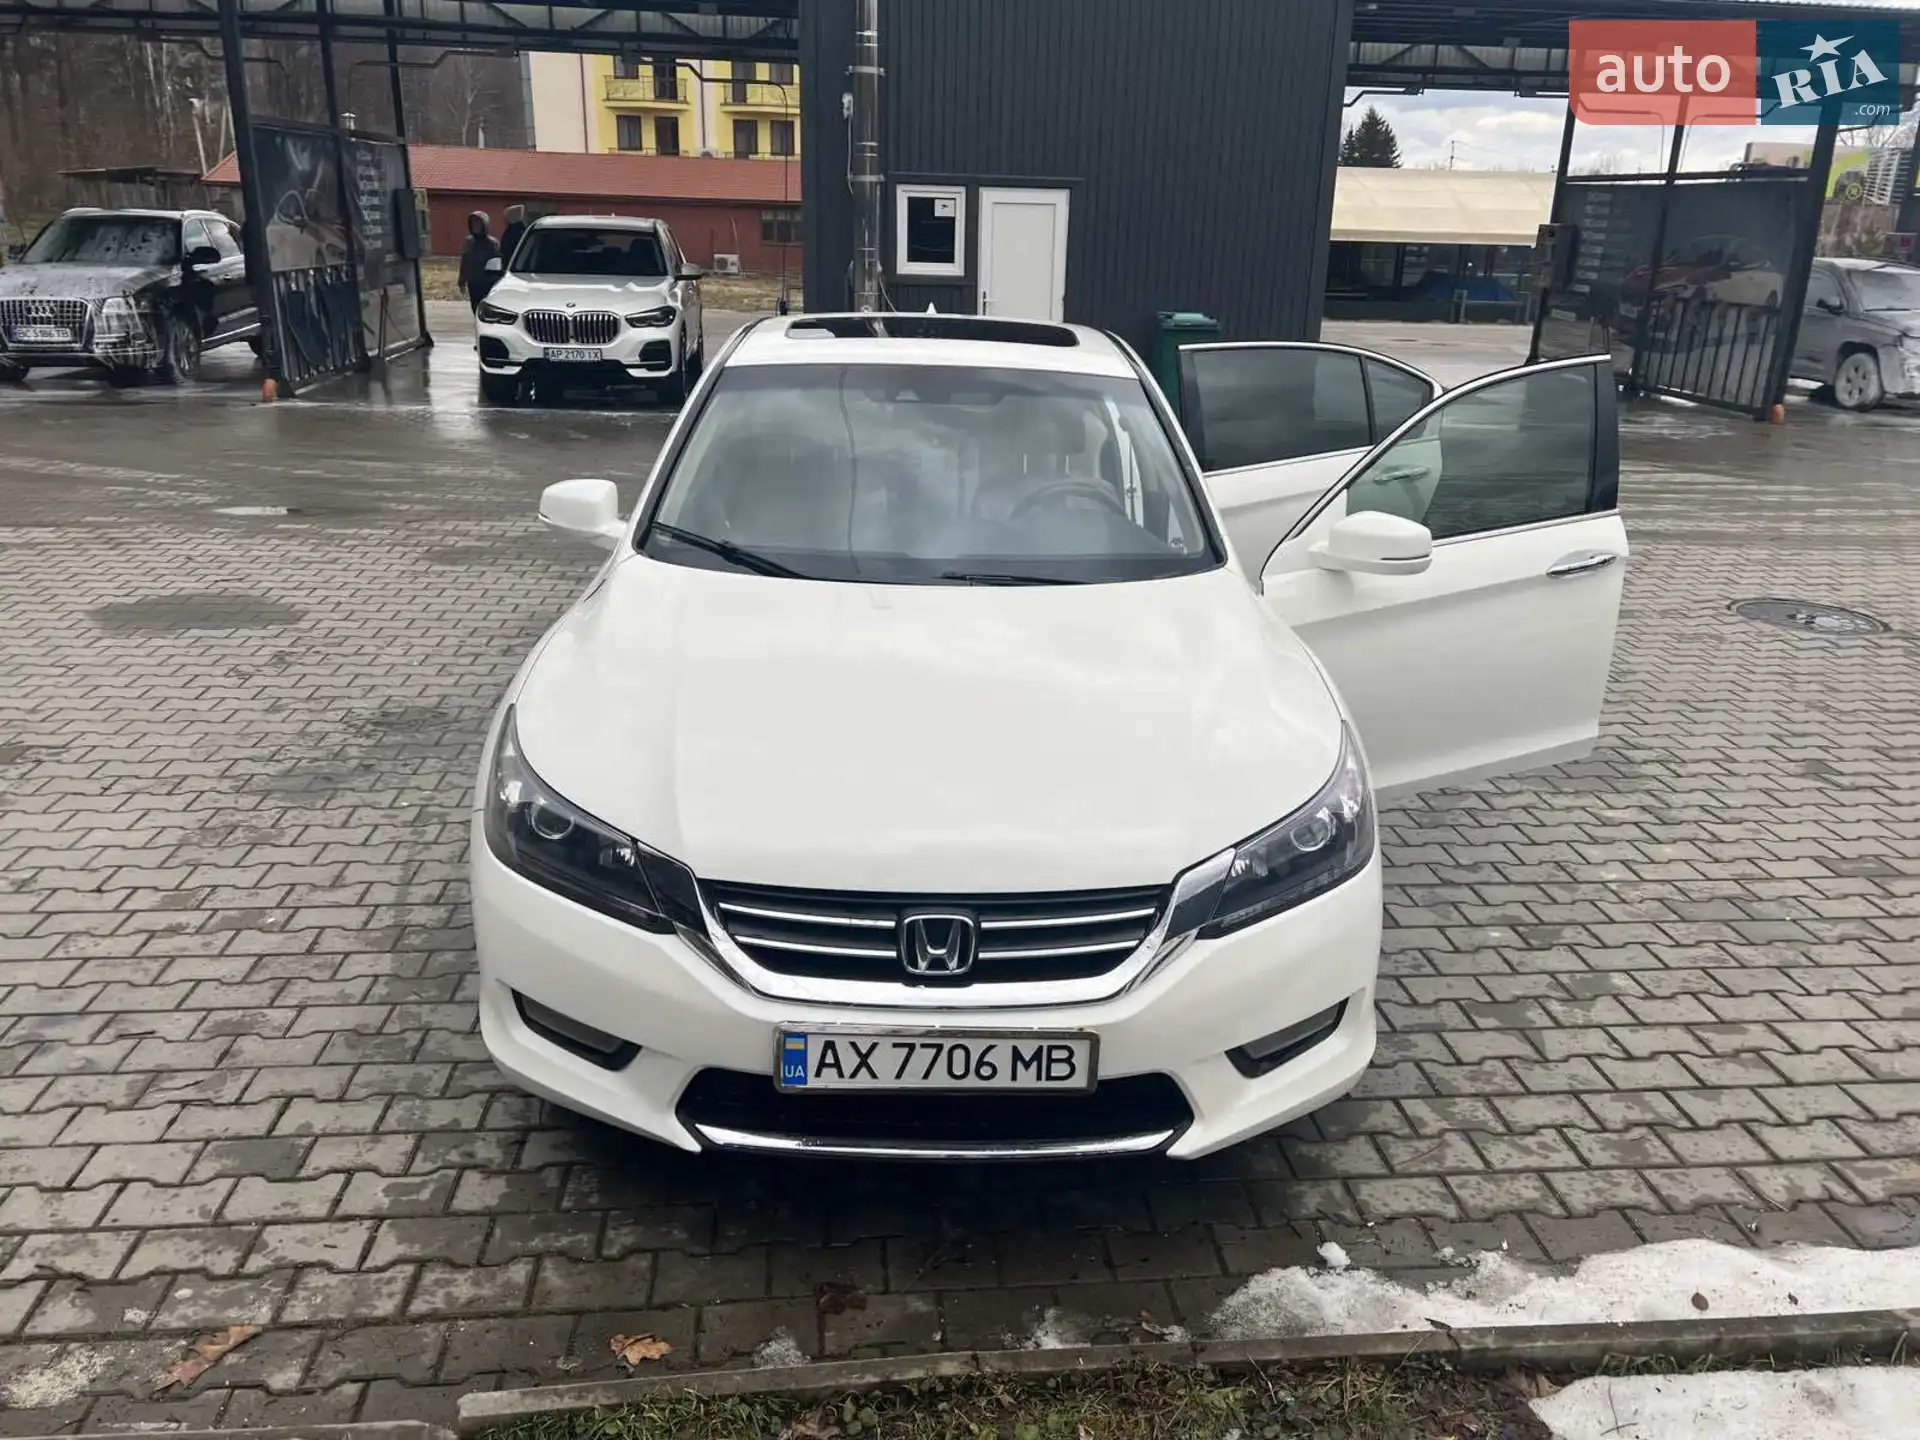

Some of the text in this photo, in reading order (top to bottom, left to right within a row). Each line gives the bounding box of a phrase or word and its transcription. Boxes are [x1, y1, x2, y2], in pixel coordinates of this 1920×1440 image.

[550, 350, 563, 359] AP
[564, 350, 586, 359] 2170
[814, 1039, 1076, 1082] AX 7706 MB
[785, 1065, 805, 1078] UA
